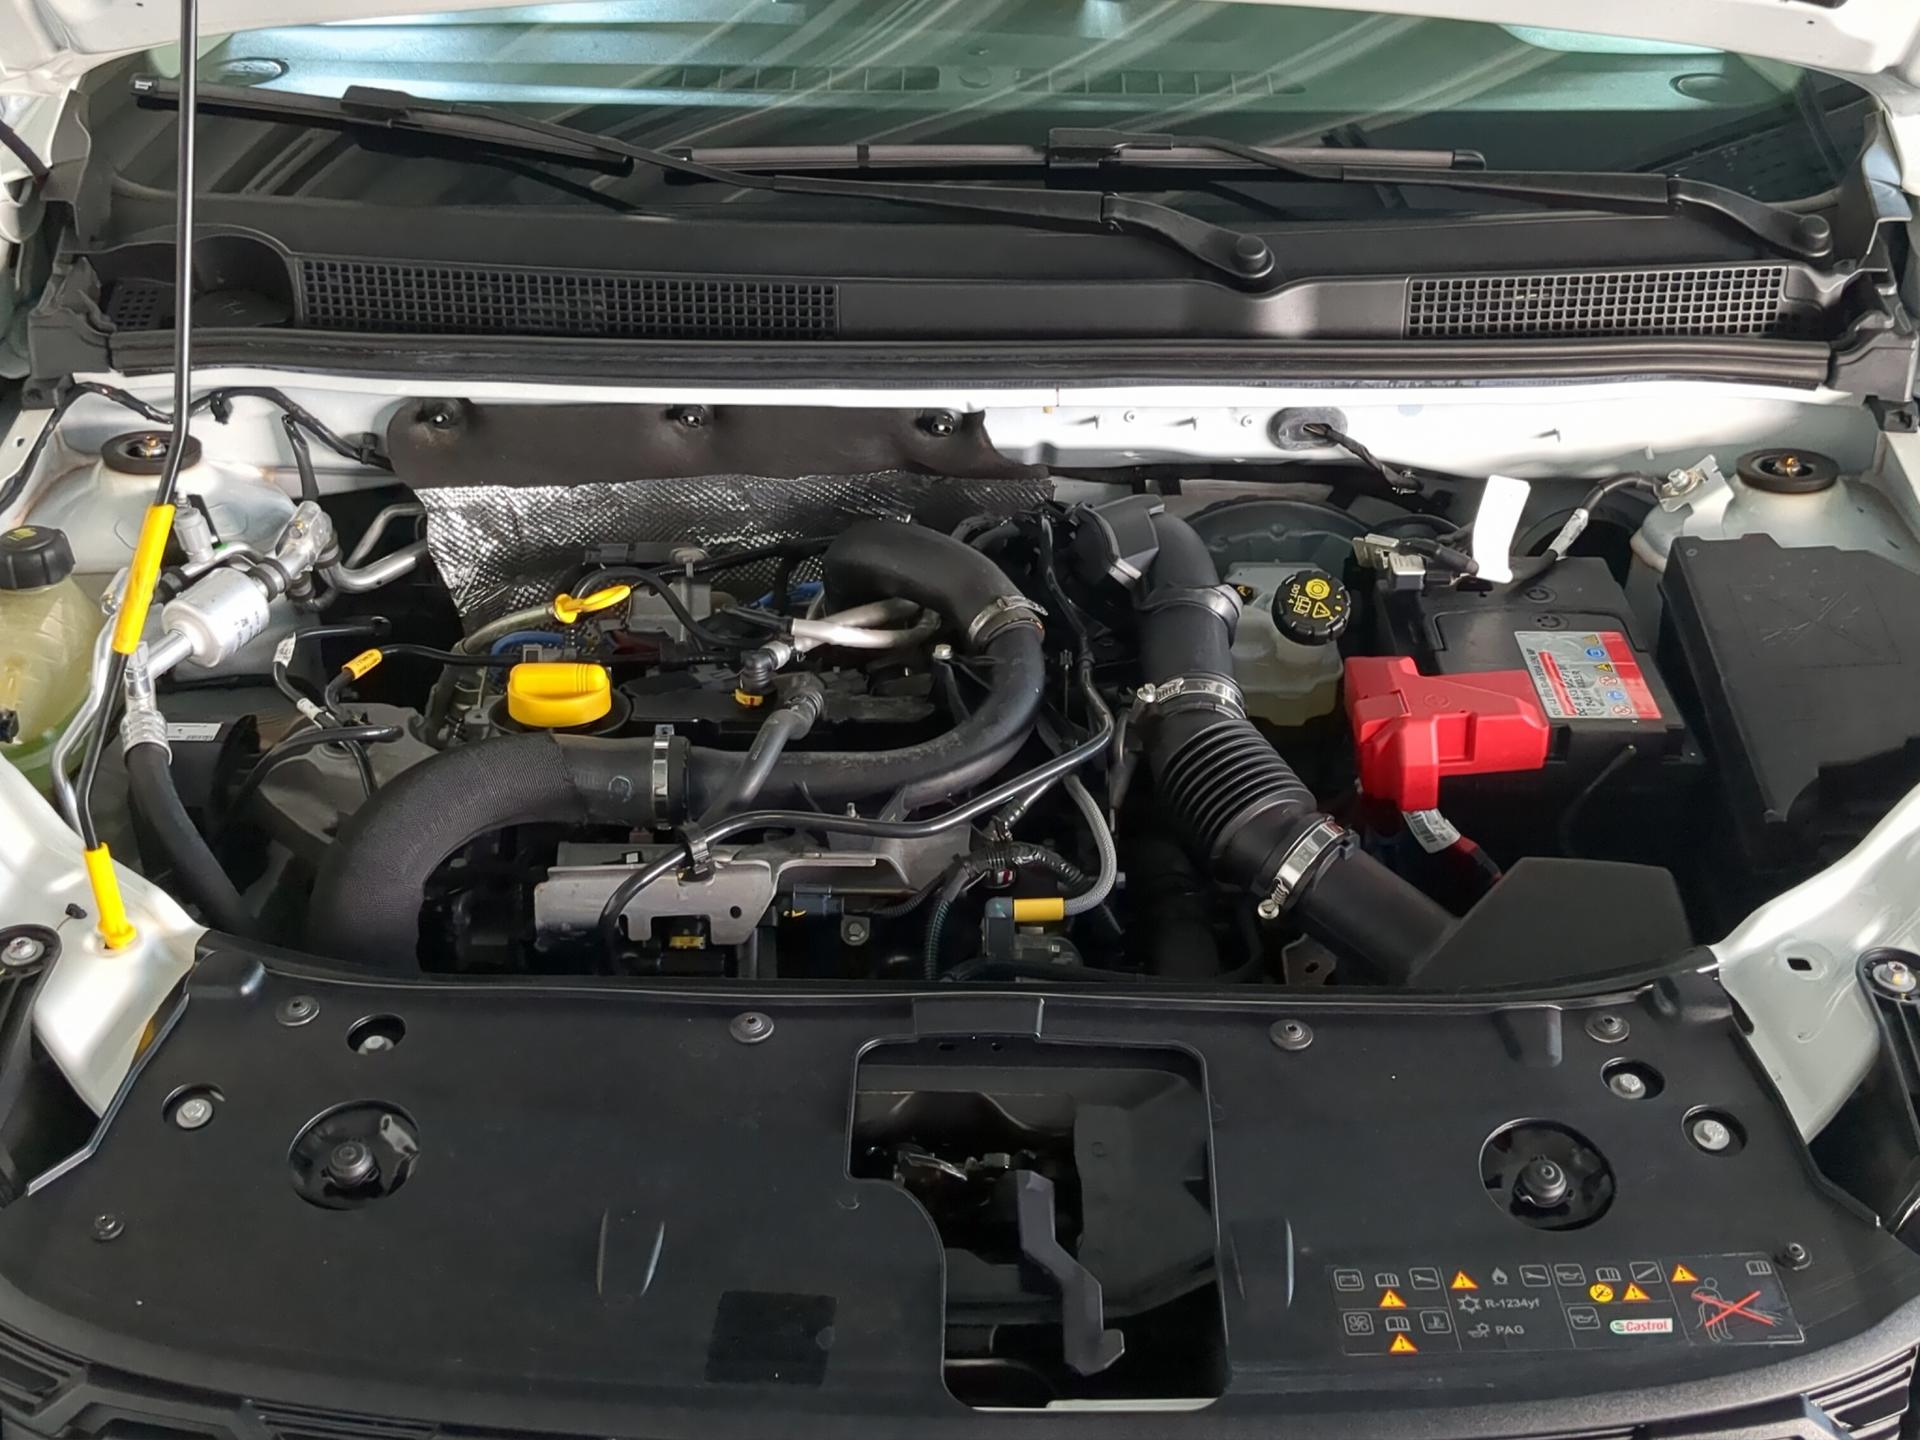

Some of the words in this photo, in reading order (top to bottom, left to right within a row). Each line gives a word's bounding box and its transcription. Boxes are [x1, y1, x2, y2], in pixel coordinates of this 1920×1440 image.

[1290, 583, 1301, 598] DOT
[1495, 1324, 1525, 1335] PAG
[1626, 1321, 1668, 1332] Castrol
